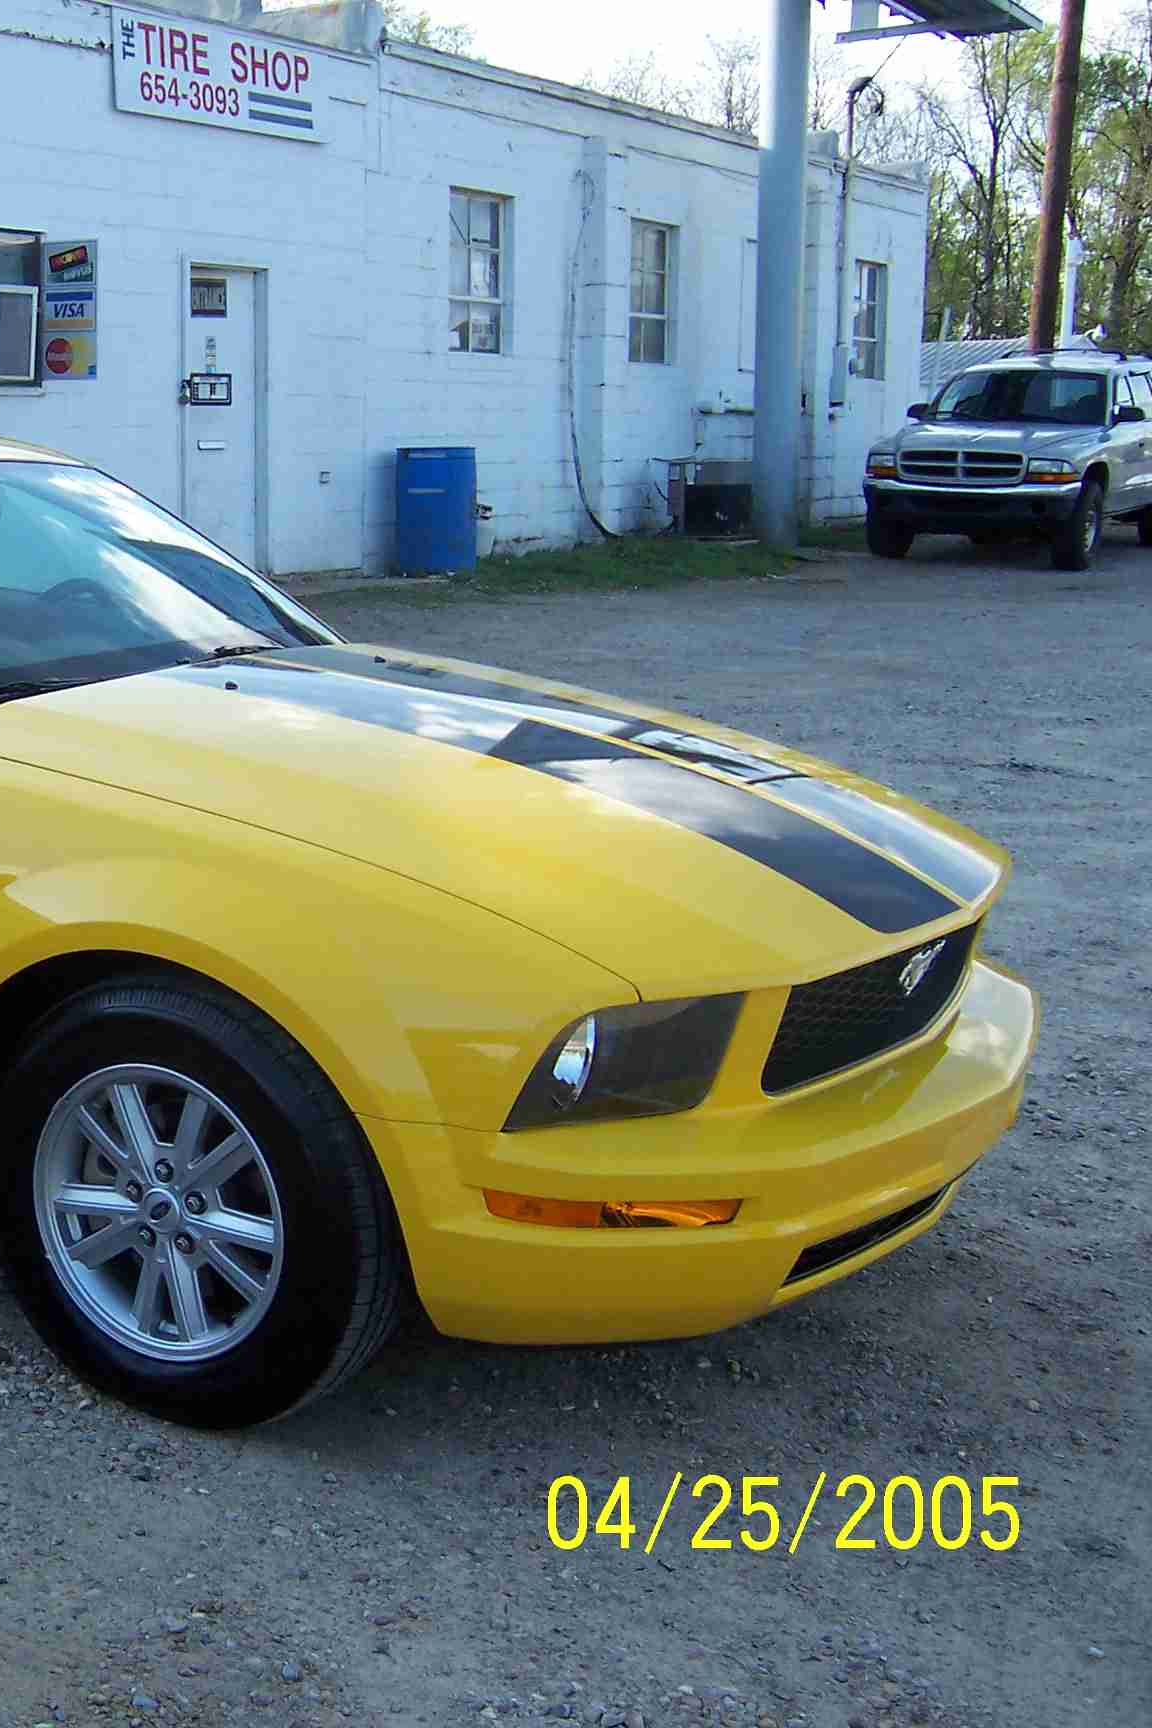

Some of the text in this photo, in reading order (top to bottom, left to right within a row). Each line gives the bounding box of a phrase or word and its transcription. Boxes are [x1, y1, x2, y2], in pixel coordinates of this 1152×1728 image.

[121, 18, 136, 60] THE
[137, 22, 309, 93] TIRE SHOP
[140, 71, 240, 117] 654-3093
[53, 303, 85, 318] VISA
